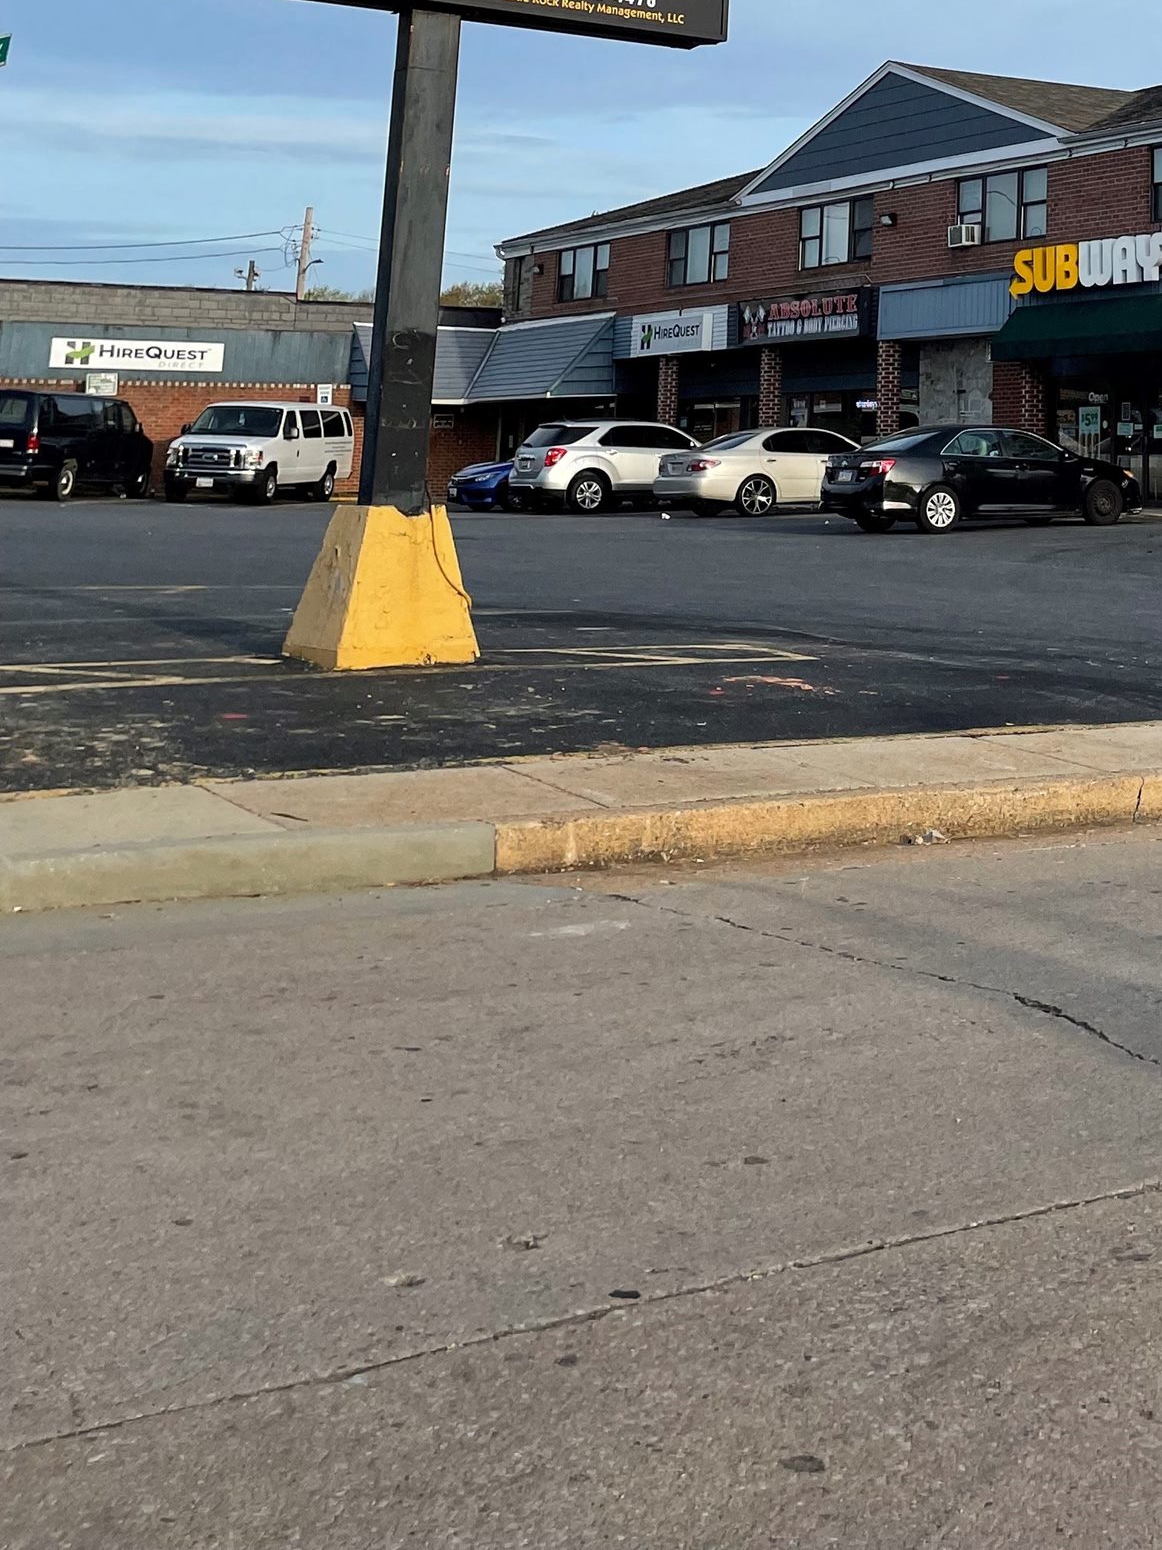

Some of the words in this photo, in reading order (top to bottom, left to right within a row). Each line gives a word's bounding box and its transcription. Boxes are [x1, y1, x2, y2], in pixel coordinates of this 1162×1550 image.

[596, 3, 665, 23] Management,
[668, 13, 685, 25] LLC
[768, 294, 858, 321] ABSOLUTE
[653, 324, 700, 340] HIREQUEST
[767, 320, 795, 338] TATTOO
[823, 313, 858, 333] PIERCING
[99, 344, 208, 361] HIREQUEST
[158, 361, 204, 369] DIRECT
[1088, 392, 1109, 403] Open
